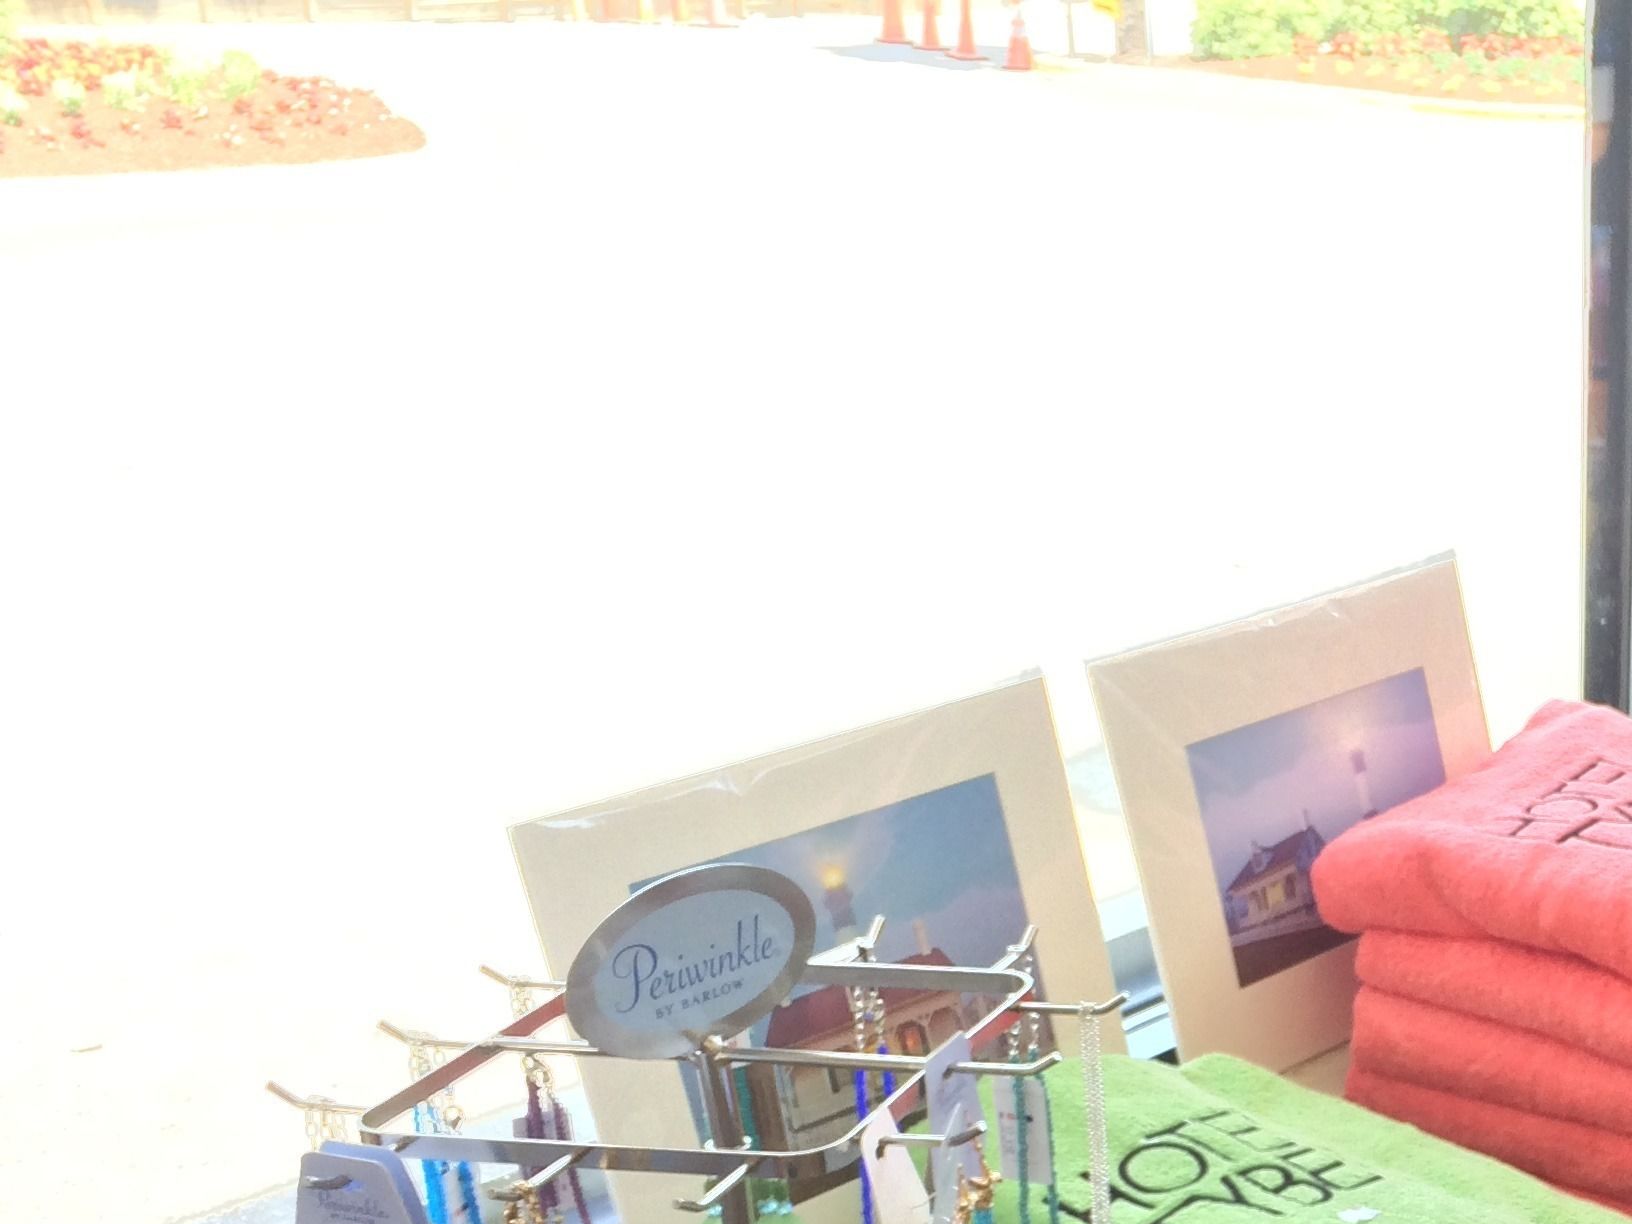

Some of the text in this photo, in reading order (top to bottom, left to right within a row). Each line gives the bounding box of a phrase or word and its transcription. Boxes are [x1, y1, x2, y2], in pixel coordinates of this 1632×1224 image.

[611, 913, 774, 1014] Periwinkle
[655, 977, 744, 1020] BY BARLOW
